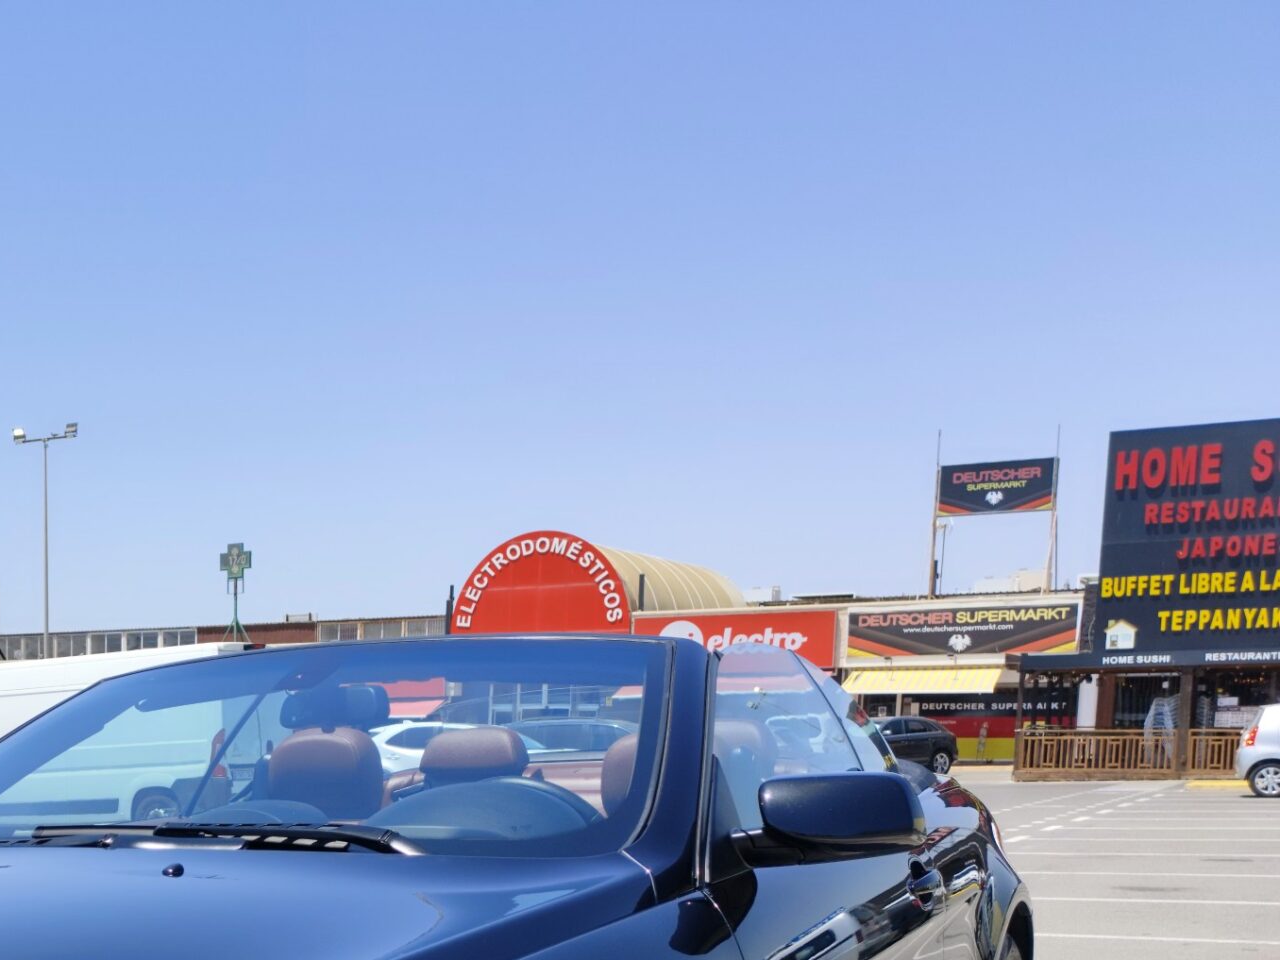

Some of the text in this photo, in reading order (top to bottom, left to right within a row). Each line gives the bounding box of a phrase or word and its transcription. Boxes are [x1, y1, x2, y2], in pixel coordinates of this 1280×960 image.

[952, 466, 1042, 484] DEUTSCHER
[1114, 438, 1280, 491] HOME S
[966, 480, 1028, 492] SUPERMARKT
[1144, 495, 1280, 525] RESTAURA
[1176, 532, 1280, 560] JAPONE
[456, 536, 623, 628] ELECTRODOMÉSTICOS
[1101, 574, 1175, 598] BUFFET
[1179, 571, 1237, 595] LIBRE
[1240, 570, 1255, 592] A
[858, 607, 1071, 628] DEUTSCHER SUPERMARKT
[903, 623, 1014, 634] www.deutschersupermarkt.com
[1102, 655, 1171, 665] HOME SUSHI
[921, 702, 985, 710] DEUTSCHER
